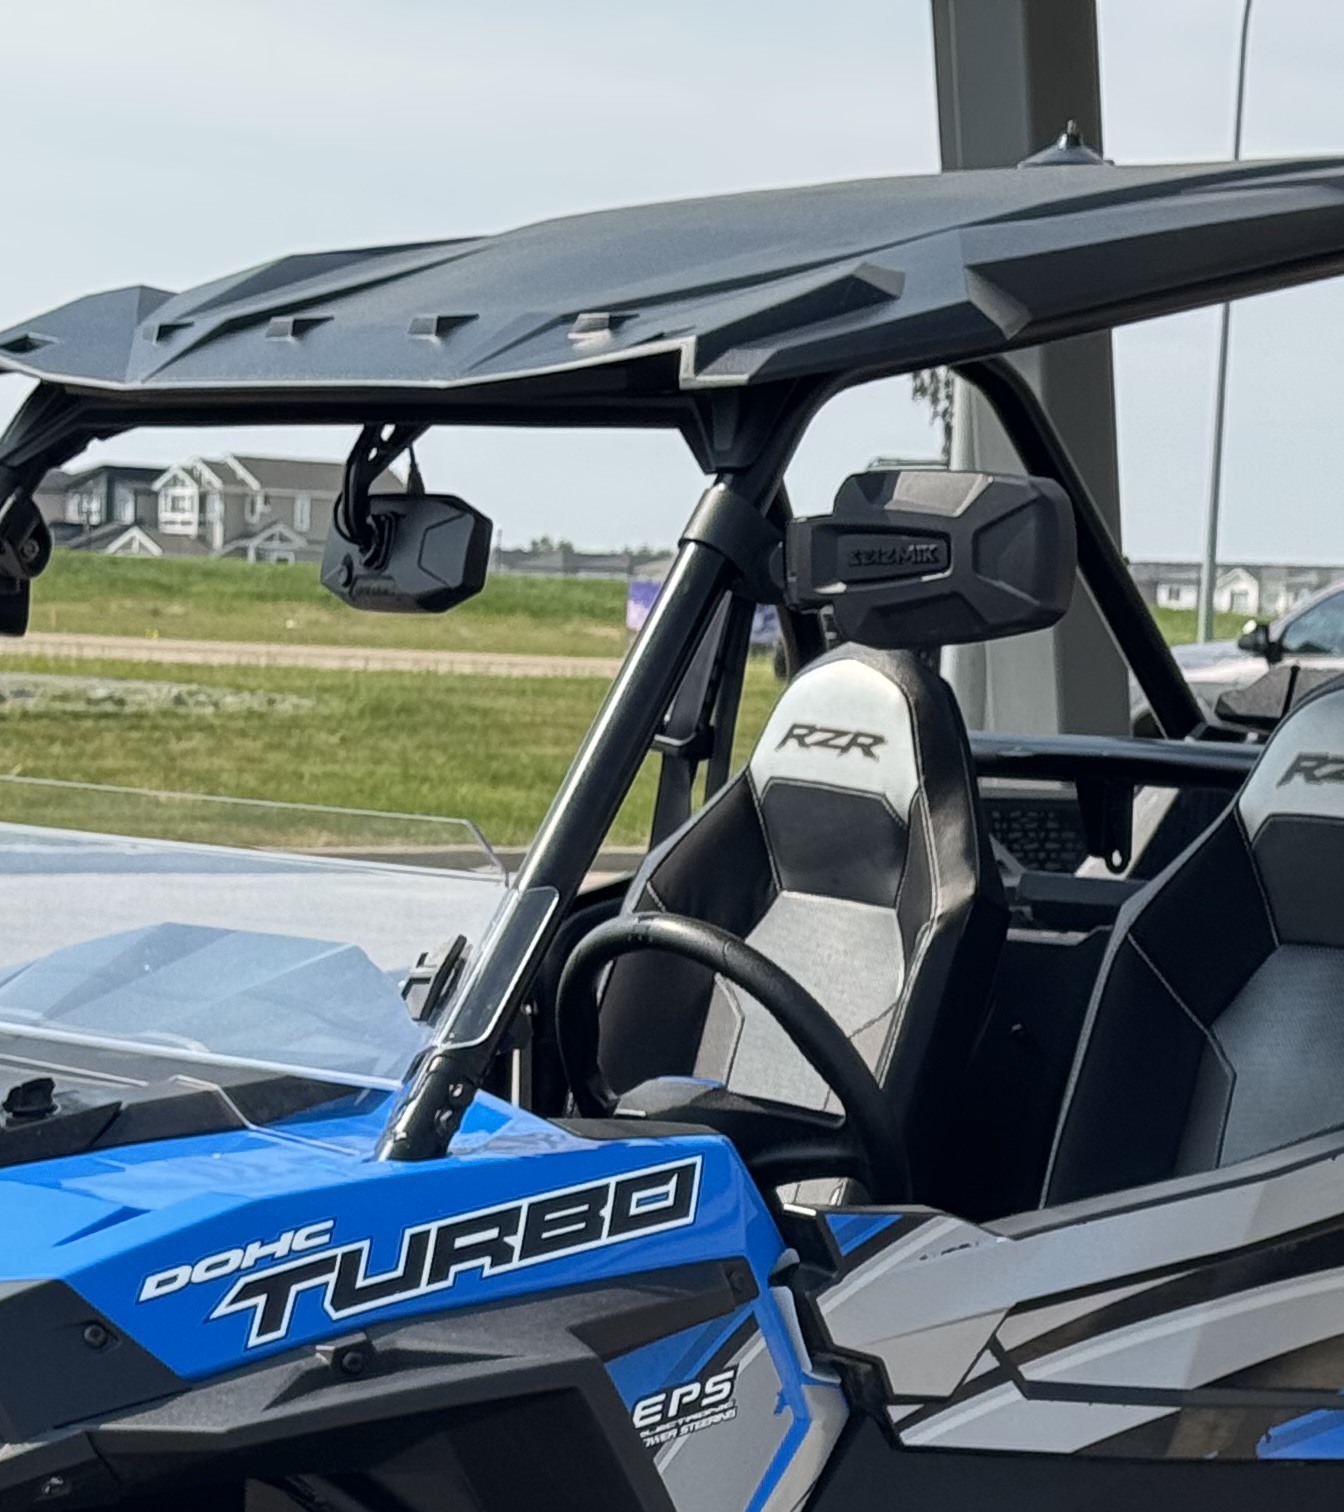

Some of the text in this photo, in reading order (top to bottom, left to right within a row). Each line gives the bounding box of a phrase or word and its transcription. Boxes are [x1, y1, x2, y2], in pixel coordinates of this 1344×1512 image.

[775, 723, 888, 763] RZR
[139, 1219, 335, 1302] DOHC
[209, 1154, 704, 1349] TURBO
[632, 1369, 735, 1429] EPS
